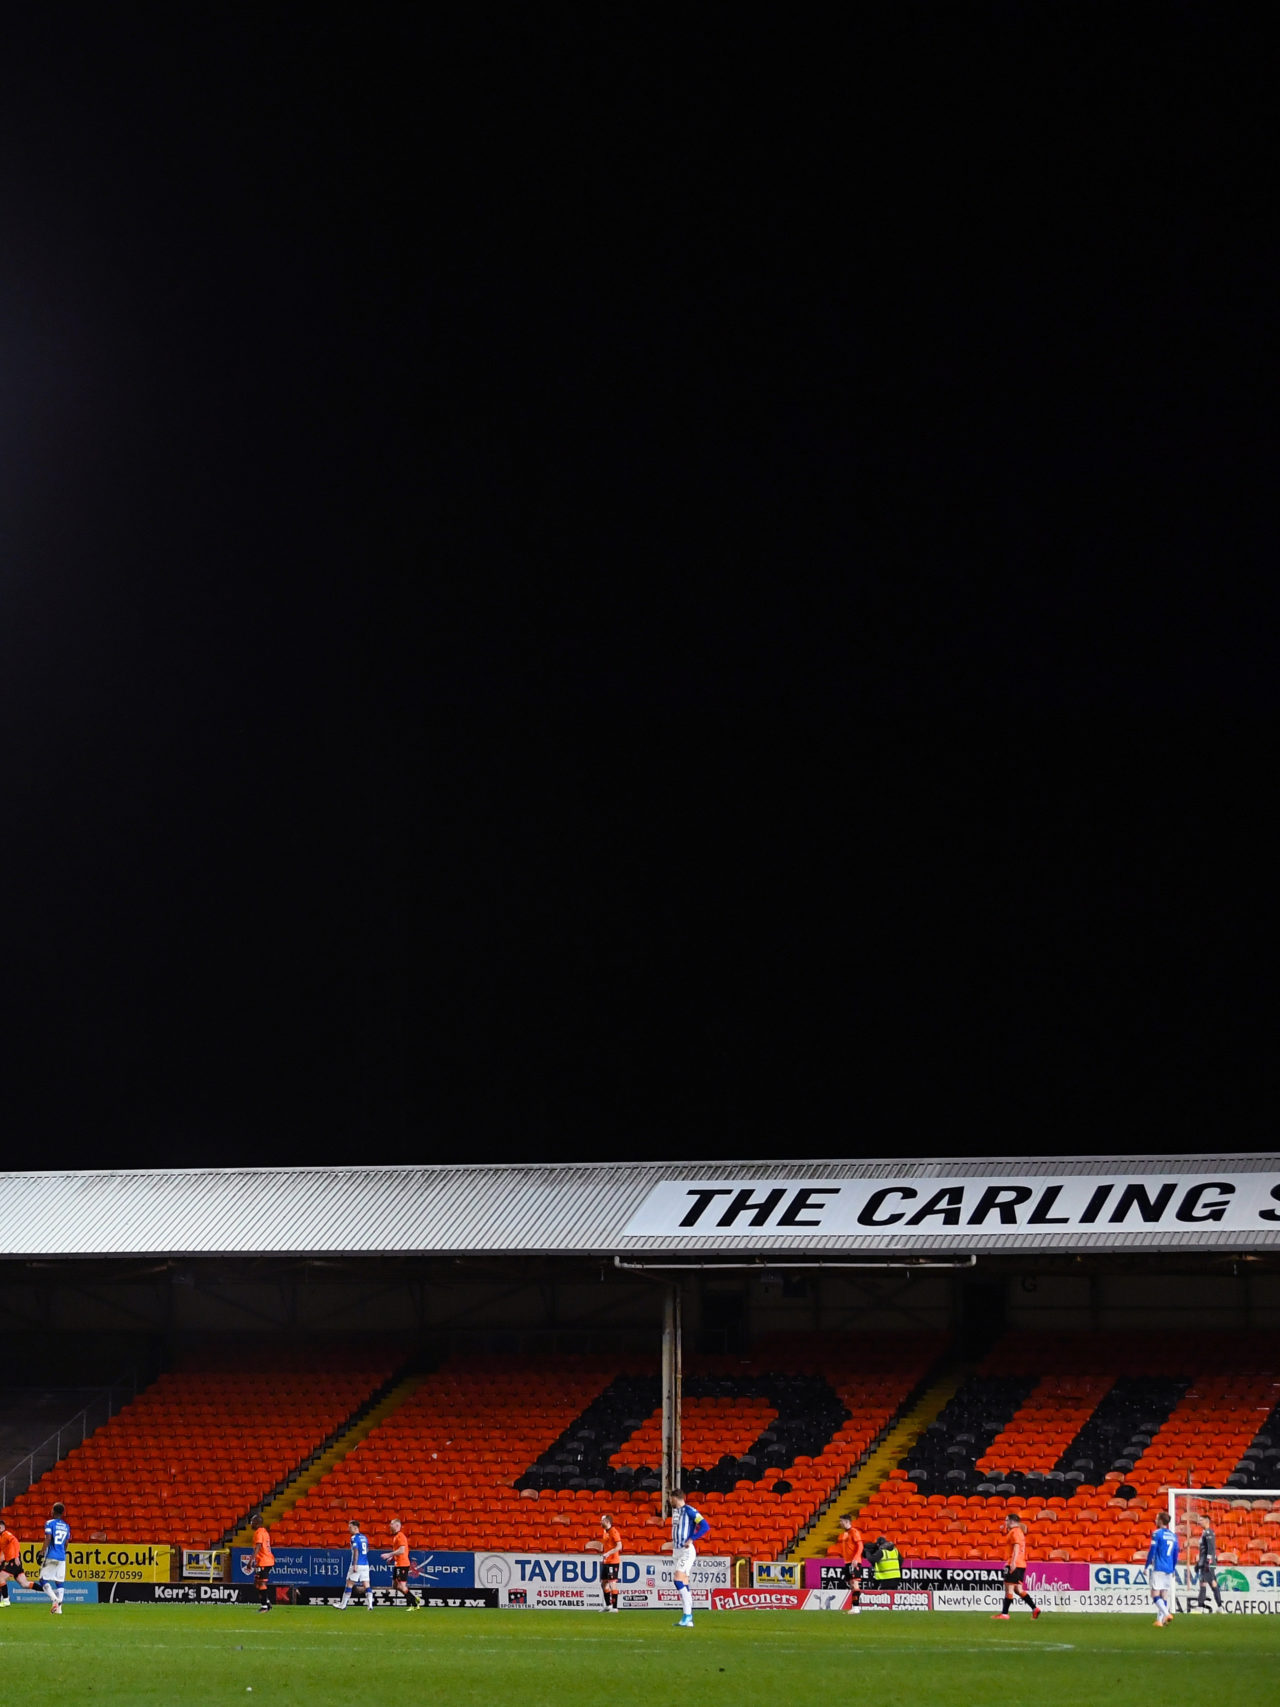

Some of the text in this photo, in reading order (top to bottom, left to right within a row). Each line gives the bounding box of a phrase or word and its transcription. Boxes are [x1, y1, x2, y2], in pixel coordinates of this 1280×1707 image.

[678, 1186, 840, 1227] THE
[857, 1181, 1236, 1227] CARLING
[54, 1530, 67, 1545] 27
[361, 1542, 368, 1555] 9
[1166, 1541, 1174, 1556] 7
[188, 1553, 221, 1567] MKM
[295, 1555, 302, 1563] of
[77, 1569, 106, 1579] 01382
[109, 1570, 143, 1579] 770599
[270, 1566, 308, 1575] Andrews
[314, 1565, 339, 1576] 1413
[515, 1559, 640, 1584] TAYBUD
[758, 1565, 794, 1579] MKM
[821, 1568, 1004, 1581] EAT, DRINK FOOTBAL
[1095, 1568, 1201, 1586] GRAAM
[692, 1572, 727, 1584] 739763
[821, 1581, 839, 1590] EAT
[897, 1582, 923, 1591] RINK
[969, 1583, 1004, 1591] DUND
[154, 1586, 239, 1601] Kerr's Dairy
[372, 1589, 423, 1598] THE
[543, 1590, 585, 1598] SUPREME
[713, 1591, 798, 1610] Falconers
[938, 1596, 983, 1607] Newtyle
[1055, 1595, 1070, 1606] Ltd
[1080, 1595, 1113, 1606] 01382
[1116, 1594, 1154, 1606] 61251
